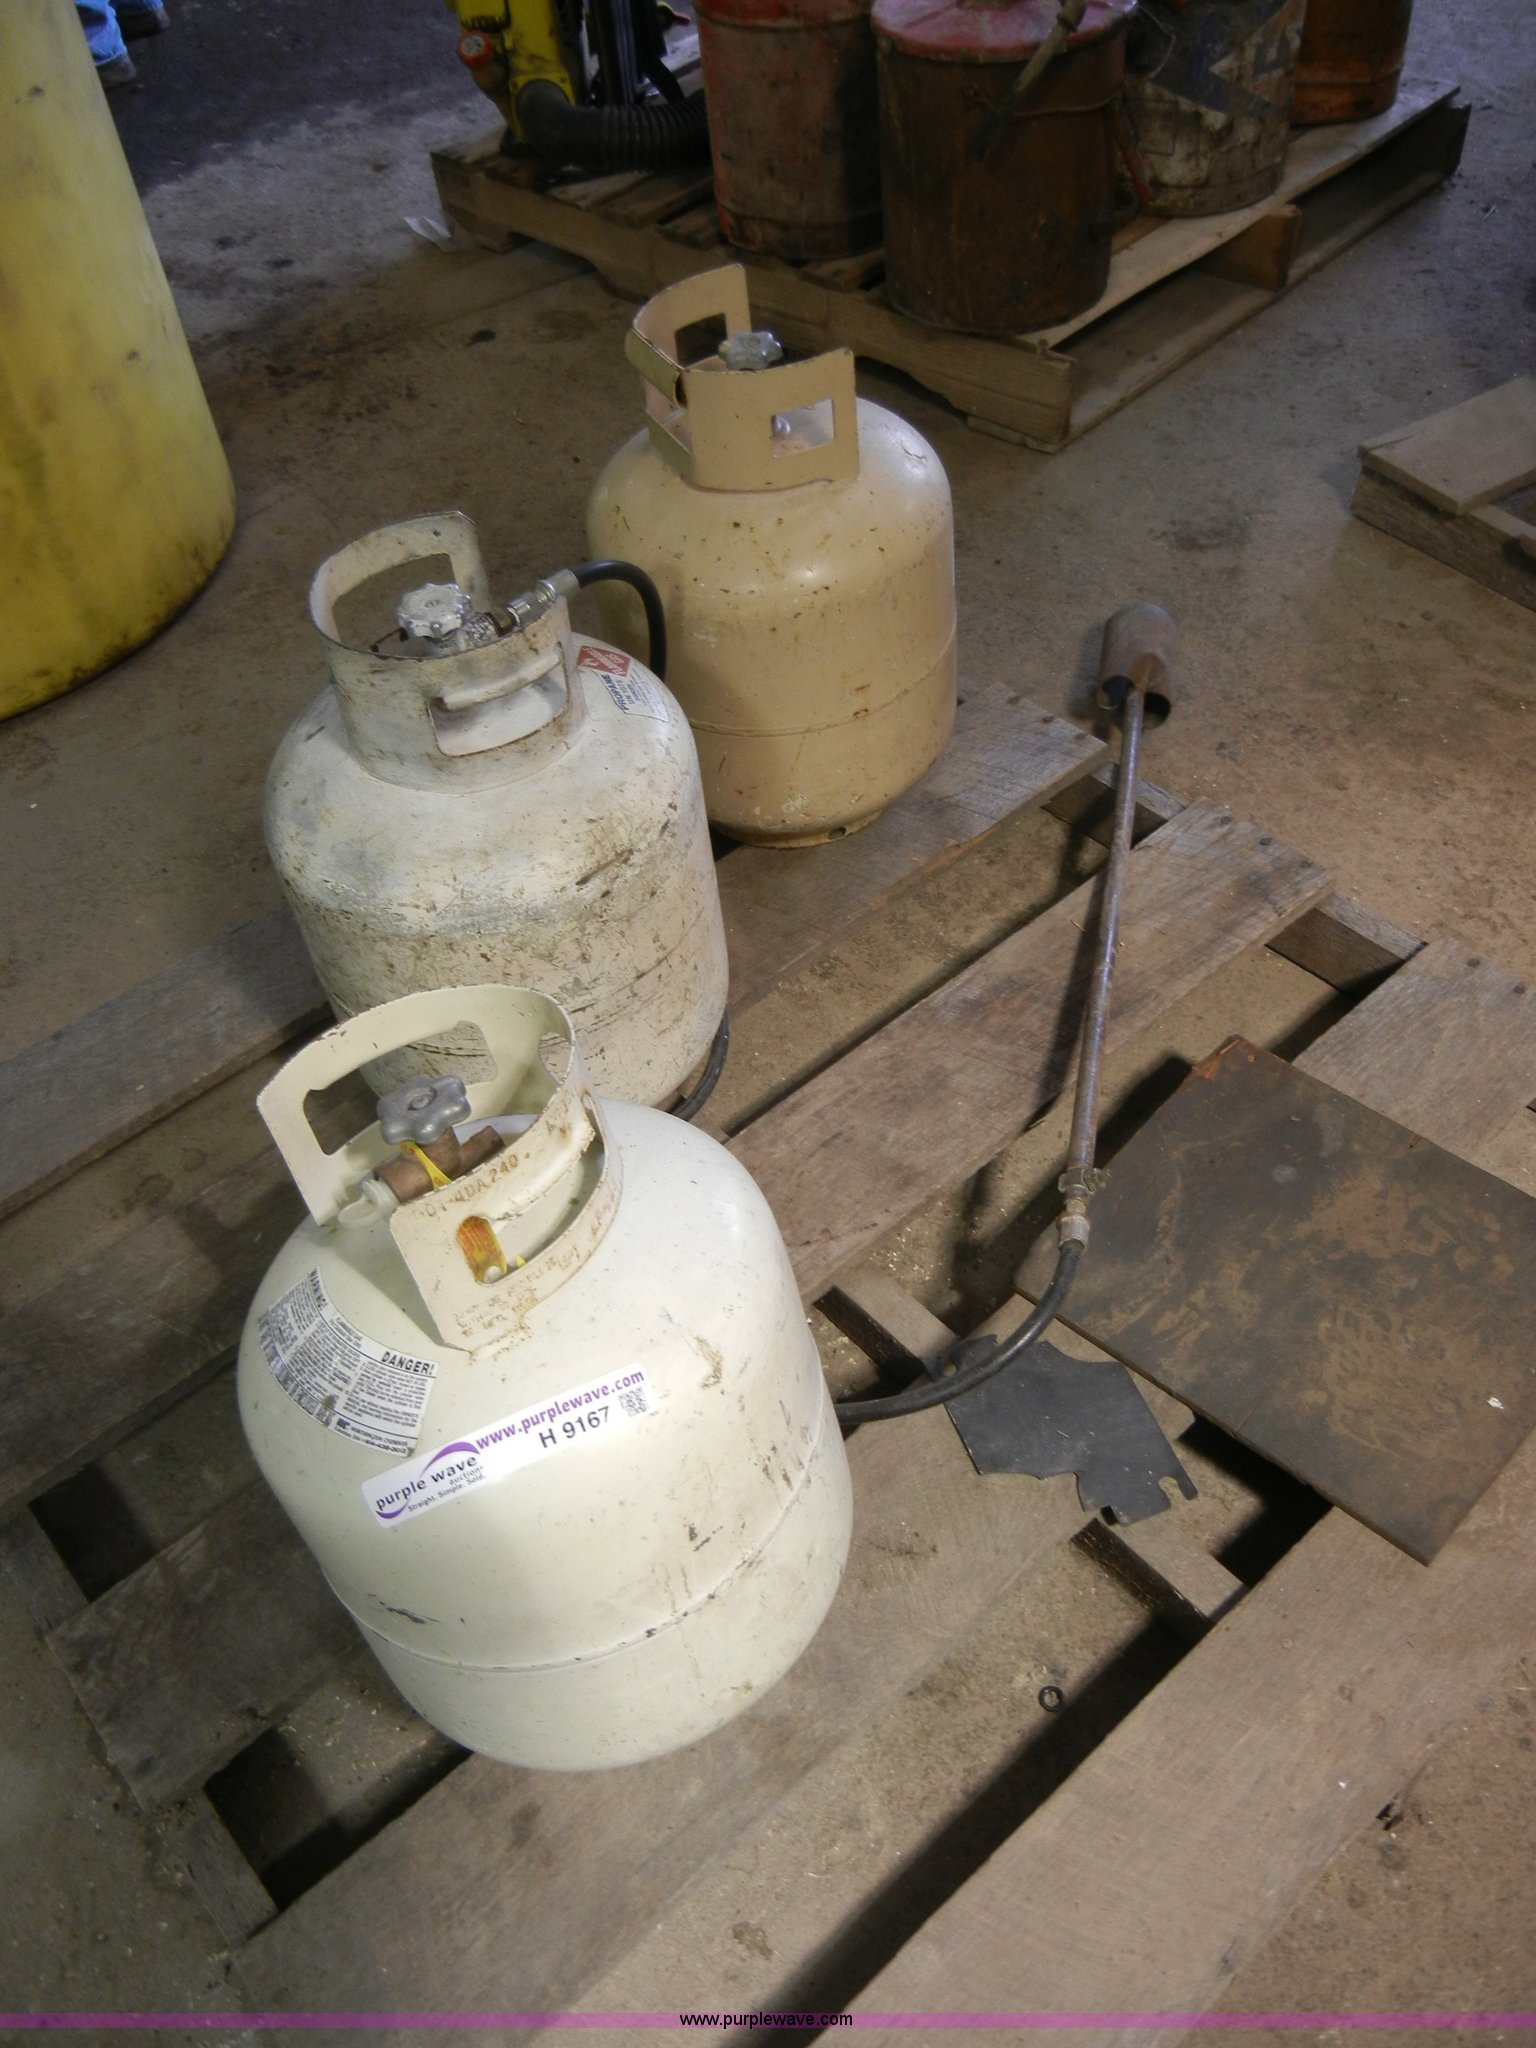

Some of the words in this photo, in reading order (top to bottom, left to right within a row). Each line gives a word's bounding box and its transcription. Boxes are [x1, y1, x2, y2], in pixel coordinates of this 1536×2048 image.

[600, 674, 630, 711] PROPANE
[381, 1351, 435, 1375] DANGER!
[475, 1371, 644, 1449] www.purplewave.com
[538, 1428, 557, 1448] H
[562, 1406, 610, 1439] 9167
[376, 1480, 427, 1511] purple
[430, 1457, 477, 1483] wave
